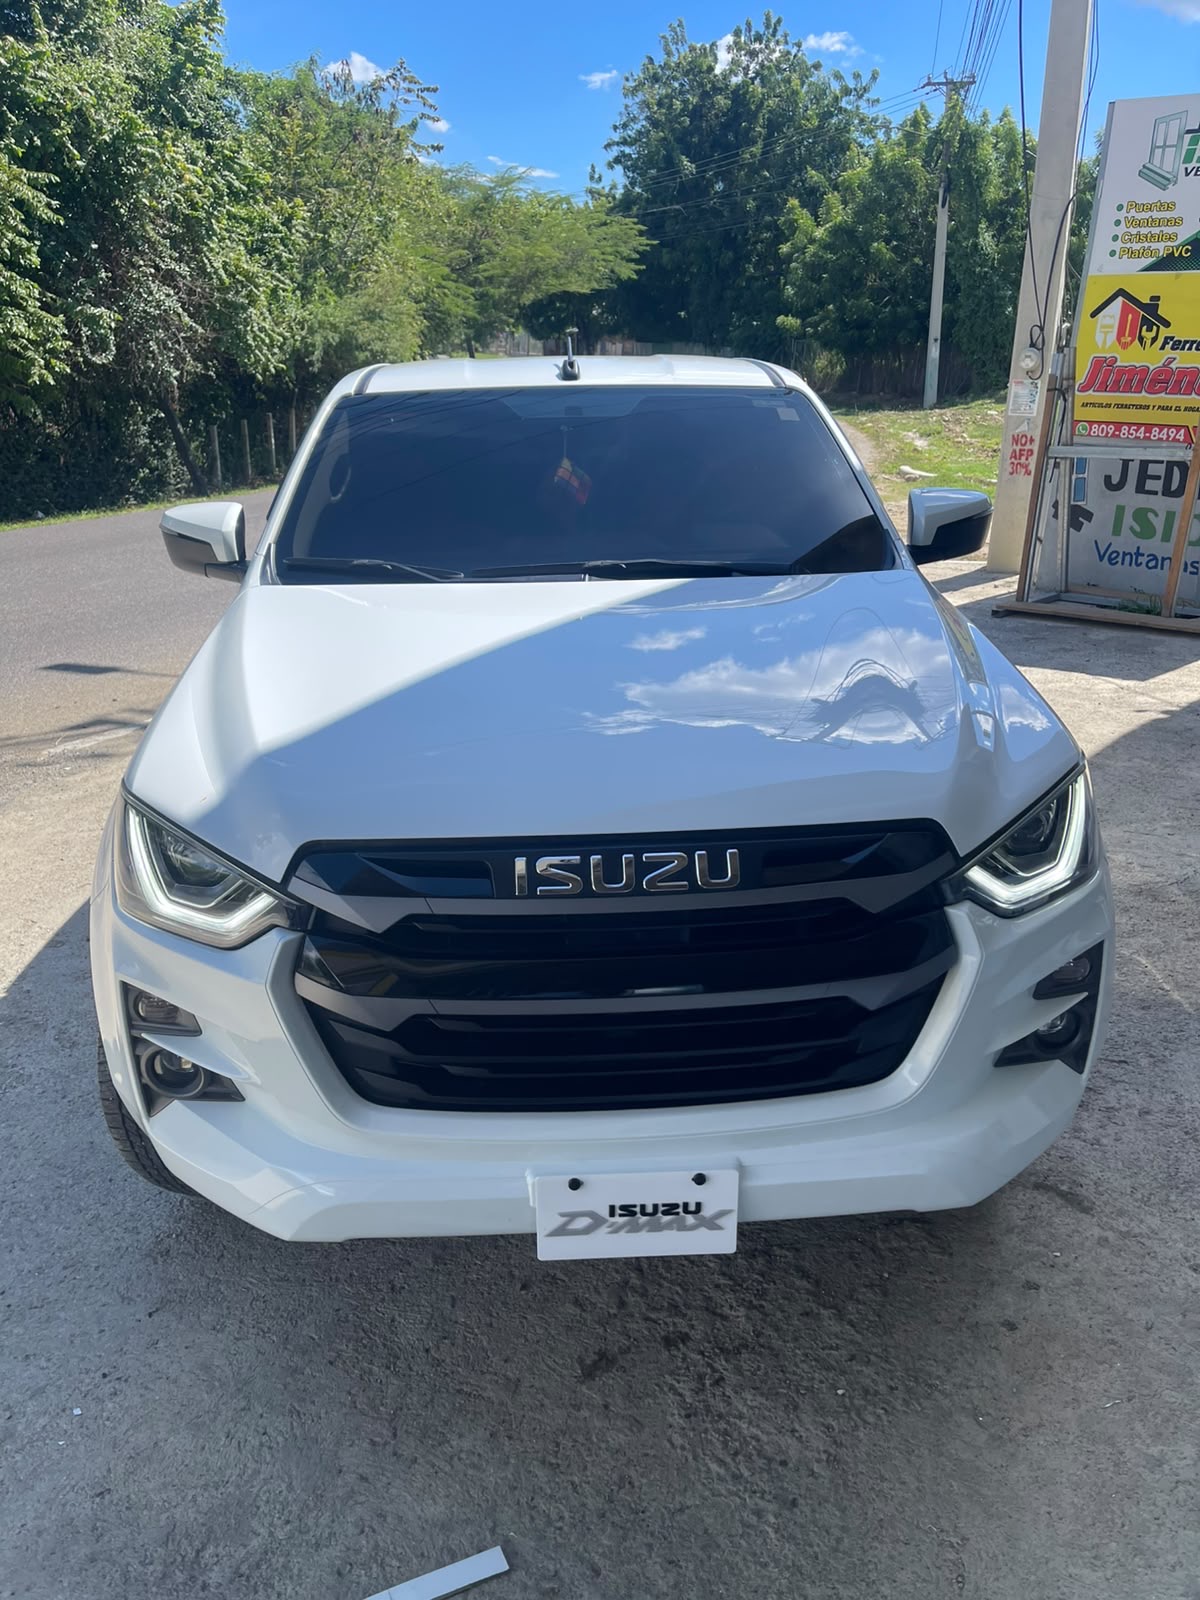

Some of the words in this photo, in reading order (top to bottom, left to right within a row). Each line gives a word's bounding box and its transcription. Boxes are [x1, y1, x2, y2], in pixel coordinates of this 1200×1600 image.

[1126, 200, 1176, 214] Puertas
[1124, 216, 1183, 228] Ventanas
[1121, 231, 1178, 244] Cristales
[1118, 247, 1159, 259] Plafón
[1163, 246, 1192, 257] PVC
[1077, 356, 1200, 396] Jimén
[1113, 403, 1150, 411] FERRETEROS
[1090, 424, 1185, 441] 809-854-8494
[1011, 434, 1035, 447] NO+
[1009, 449, 1034, 461] AFP
[1009, 462, 1032, 476] 30%
[1103, 458, 1200, 498] JED
[514, 848, 741, 896] ISUZU
[608, 1201, 702, 1218] ISUZU
